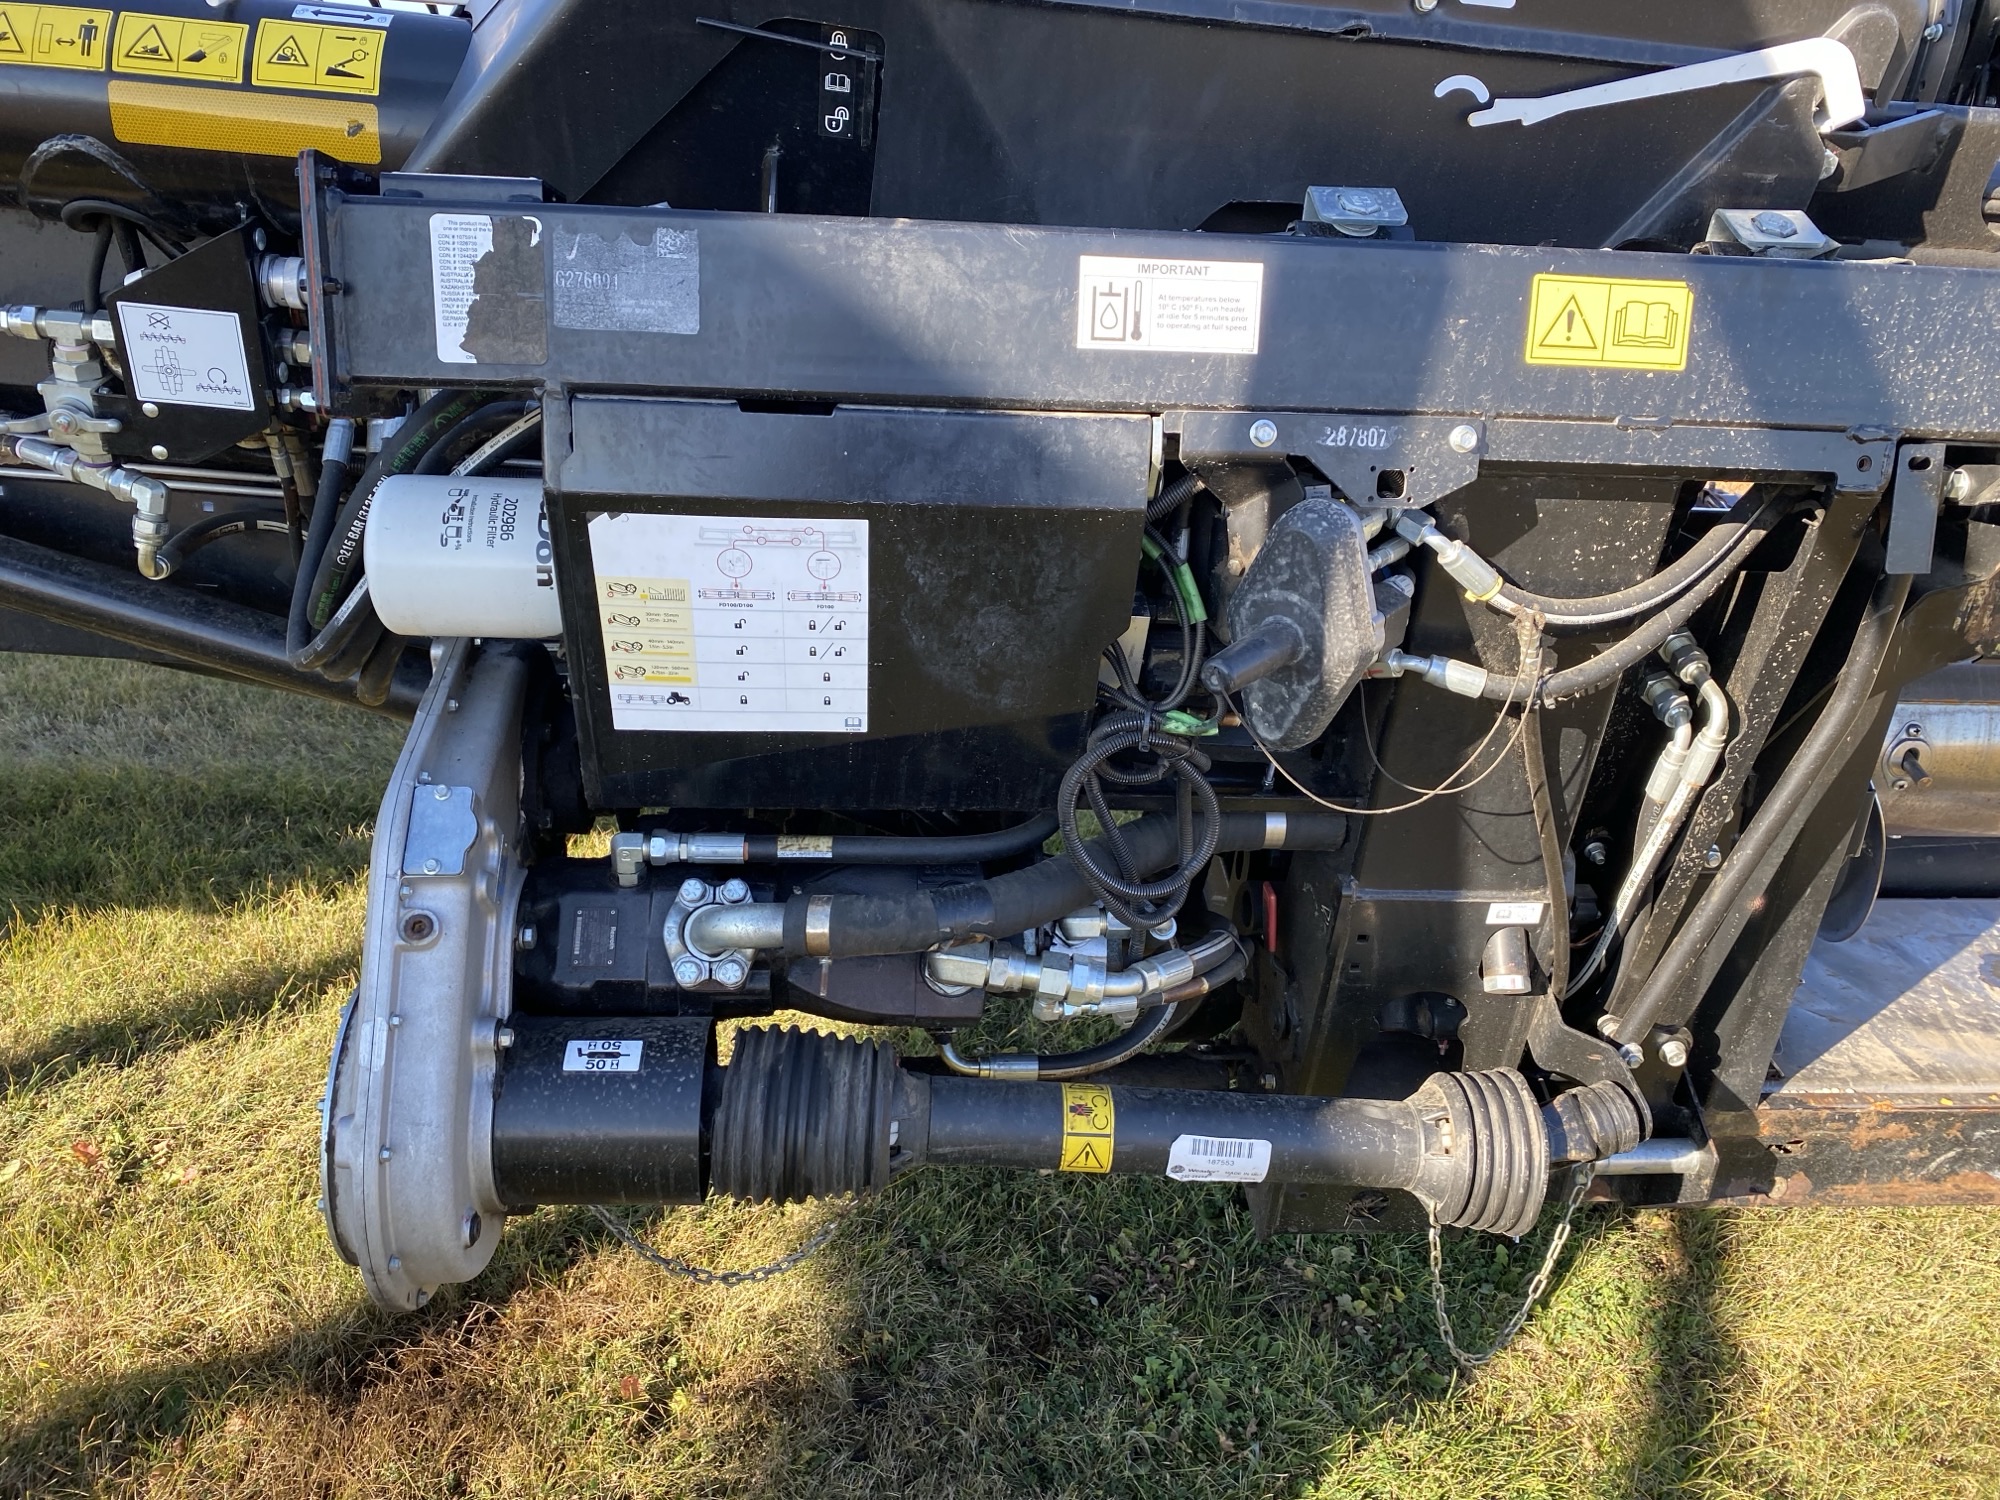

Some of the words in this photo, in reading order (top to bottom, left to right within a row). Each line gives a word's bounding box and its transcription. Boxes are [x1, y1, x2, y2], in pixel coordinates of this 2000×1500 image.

[1137, 263, 1210, 276] IMPORTANT
[1168, 294, 1217, 304] temperatures
[1218, 296, 1241, 304] below
[1221, 305, 1245, 313] header
[1193, 313, 1199, 321] 5
[1200, 314, 1229, 322] minutes
[1230, 315, 1249, 323] prior
[1166, 322, 1201, 332] operating
[1211, 323, 1225, 331] full
[470, 494, 479, 515] Installation
[487, 492, 503, 525] Hydraulic
[500, 498, 519, 541] 202986
[347, 519, 366, 540] BAR
[466, 515, 475, 543] Instructions
[486, 525, 497, 549] Filter
[340, 539, 356, 559] 215
[601, 1041, 622, 1051] 50
[585, 1059, 606, 1070] 50
[1207, 1159, 1235, 1167] 187553
